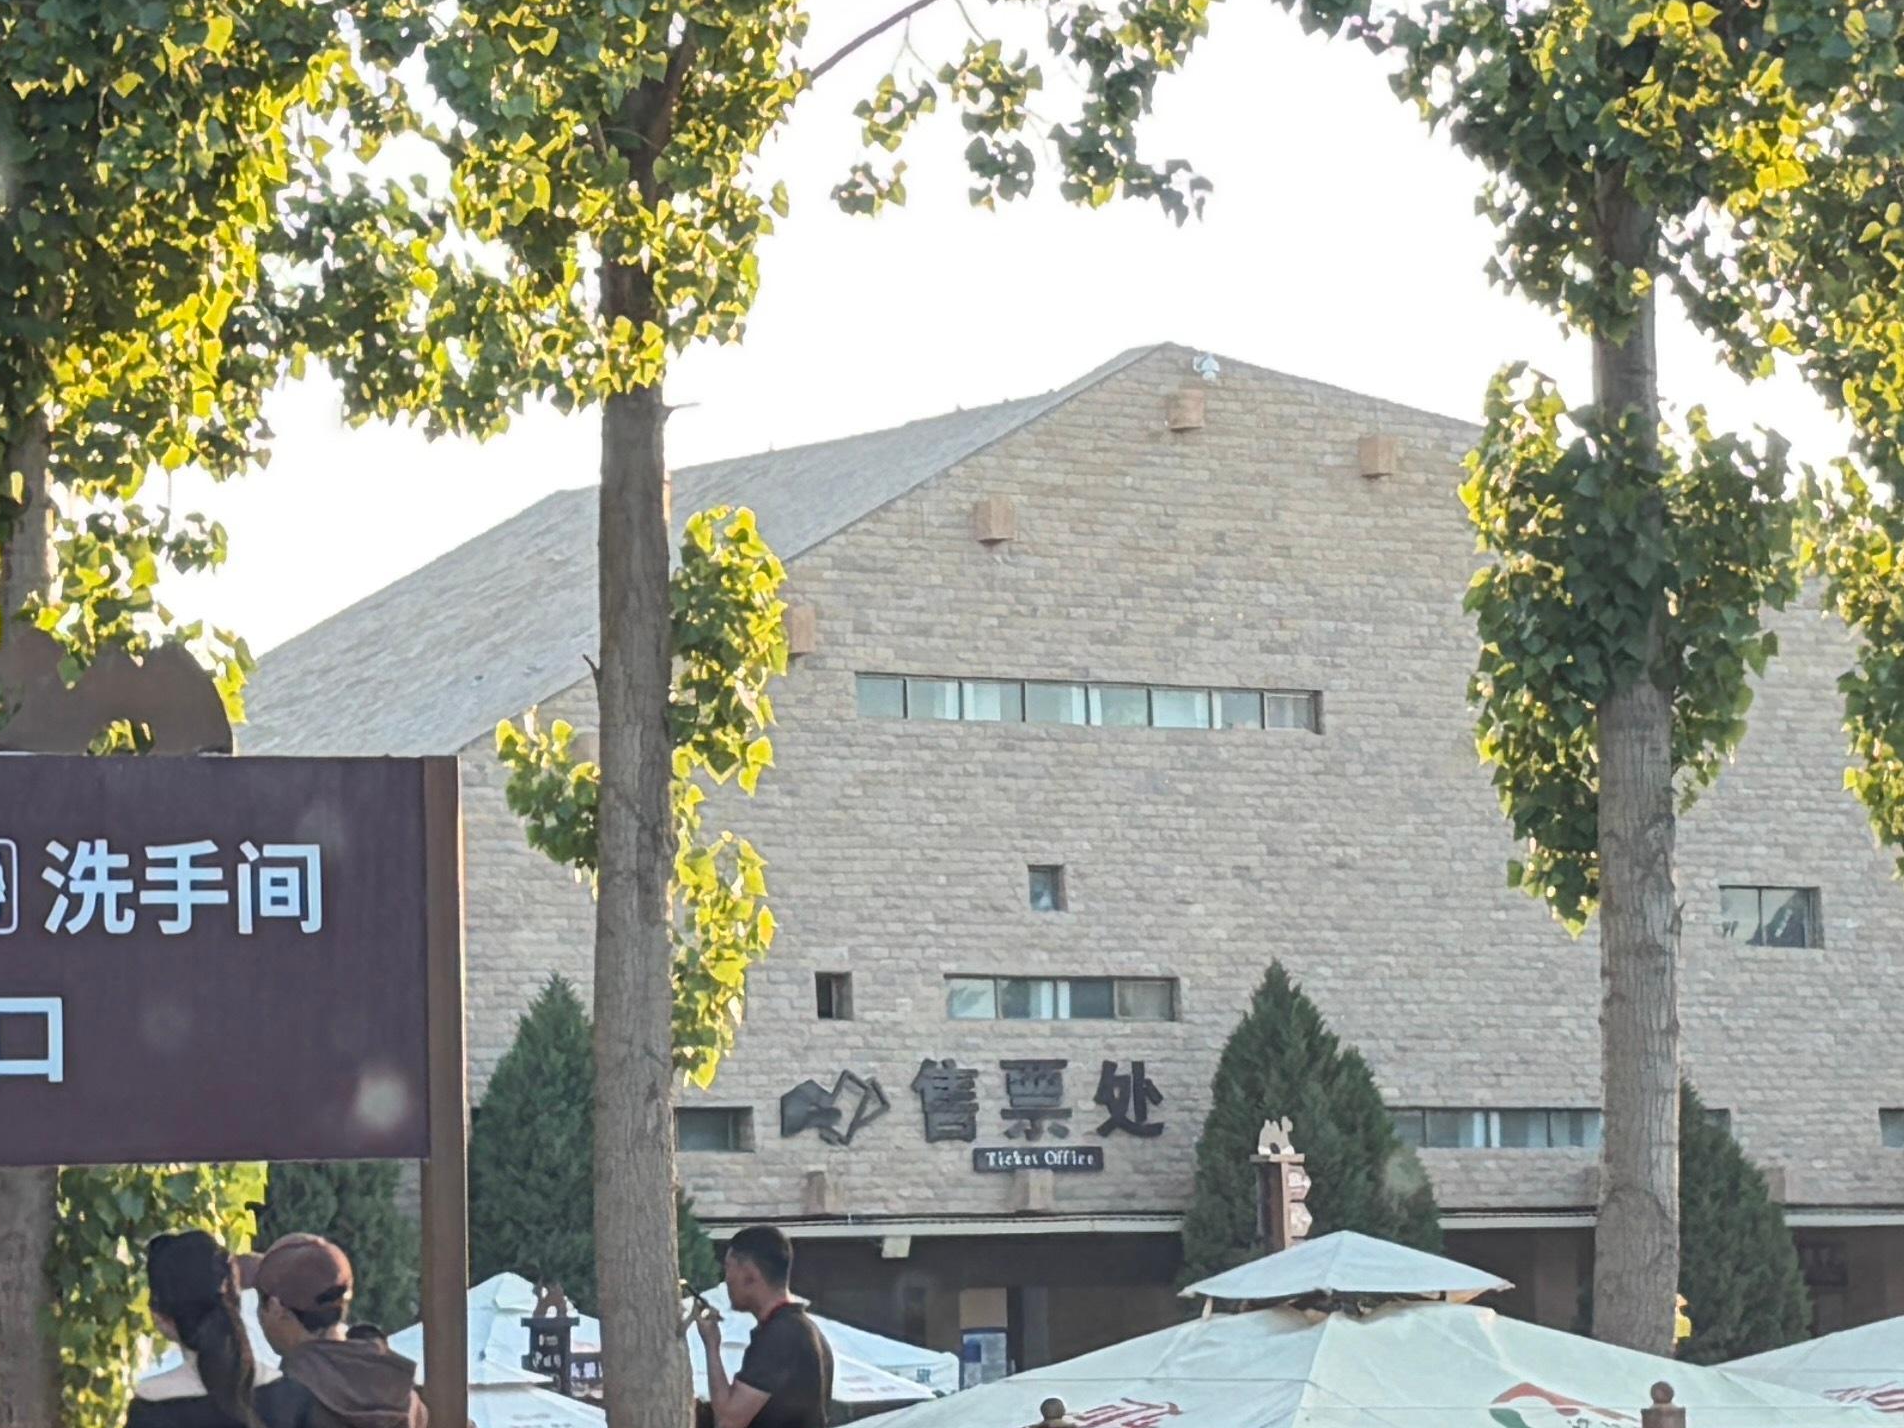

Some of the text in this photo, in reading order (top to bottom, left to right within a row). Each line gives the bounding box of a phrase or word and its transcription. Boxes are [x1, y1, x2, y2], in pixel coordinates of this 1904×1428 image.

[40, 838, 323, 936] 洗手间
[911, 1058, 1165, 1143] 售票处
[985, 1149, 1094, 1167] Ticket Office
